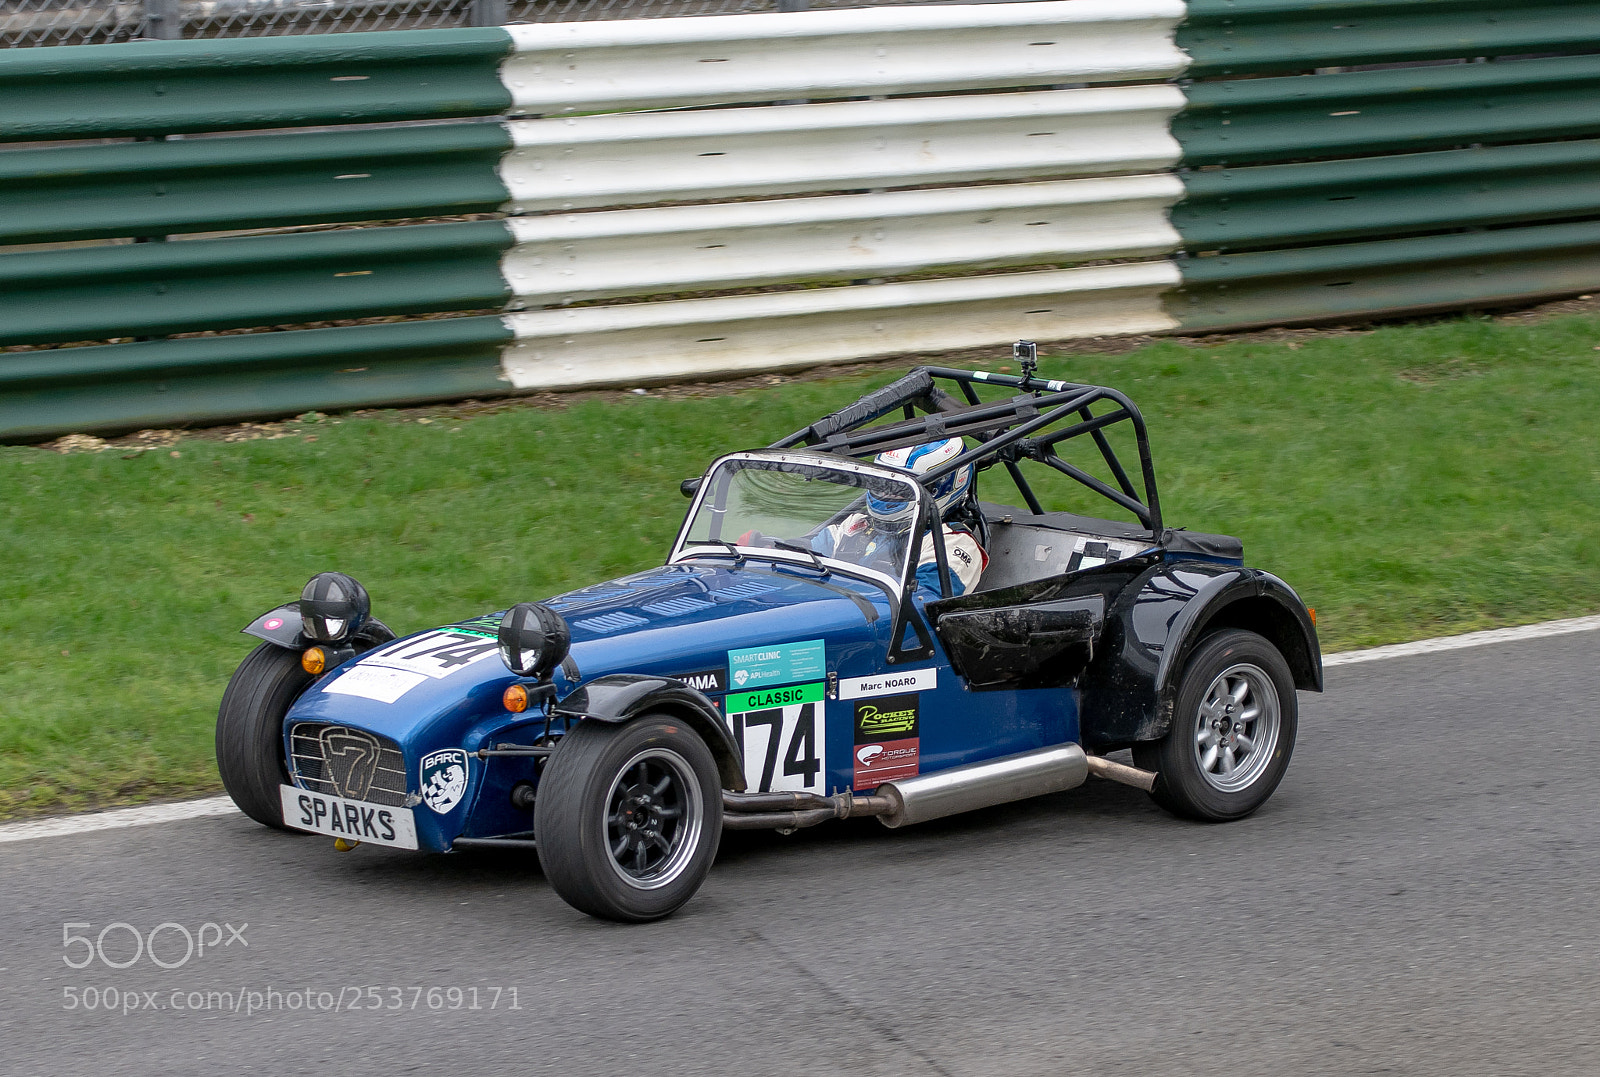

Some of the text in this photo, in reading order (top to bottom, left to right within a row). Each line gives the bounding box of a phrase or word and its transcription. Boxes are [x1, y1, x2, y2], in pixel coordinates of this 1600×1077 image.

[379, 632, 499, 668] 174
[733, 651, 781, 664] SMARTCLINIC
[860, 677, 917, 691] Marc NOARO
[748, 689, 803, 707] CLASSIC
[881, 747, 917, 756] TORQUE
[424, 752, 463, 770] BARC
[299, 795, 396, 841] SPARKS
